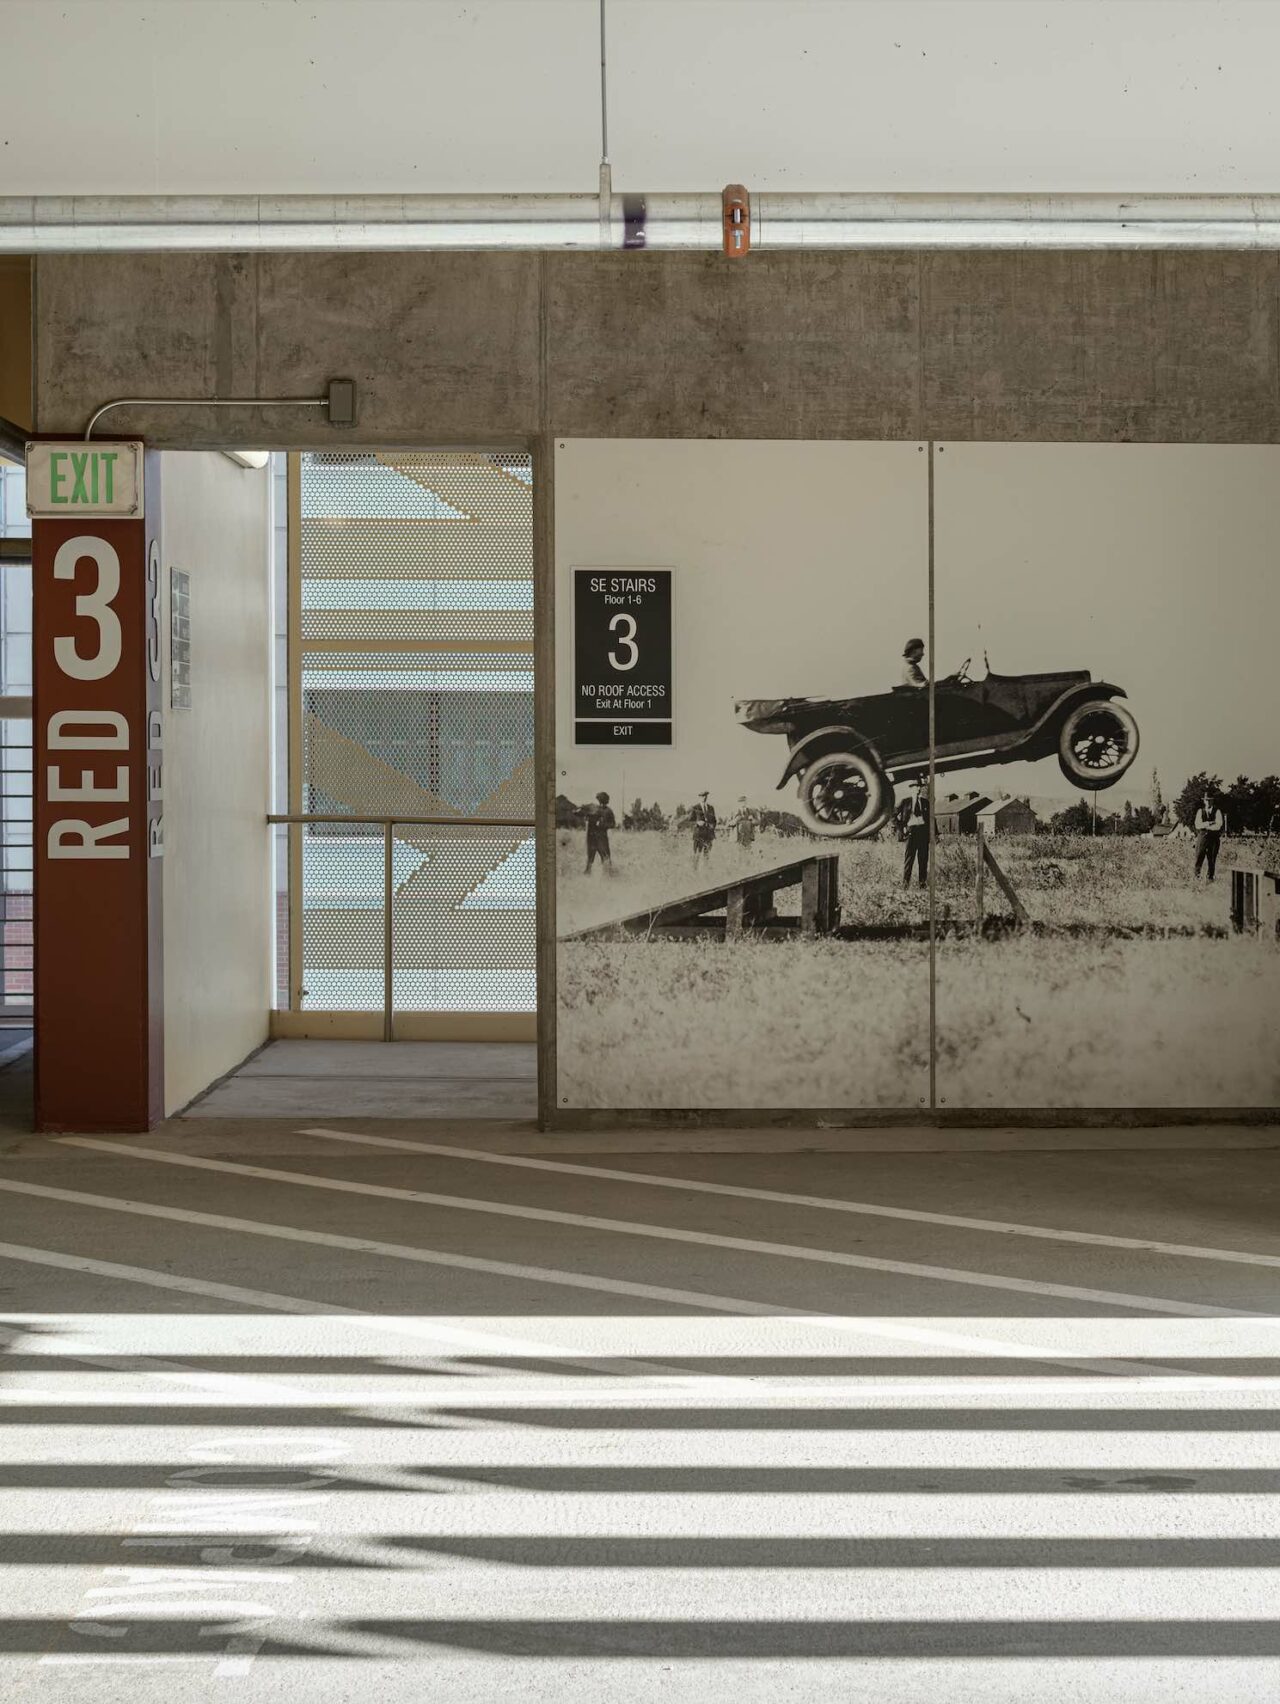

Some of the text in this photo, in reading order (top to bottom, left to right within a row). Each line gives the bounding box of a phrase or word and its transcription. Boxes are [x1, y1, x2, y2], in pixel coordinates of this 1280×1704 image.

[49, 452, 118, 504] EXIT
[53, 535, 122, 681] 3
[148, 539, 162, 682] 3
[590, 577, 656, 593] SE STAIRS
[604, 594, 642, 605] Floor 1-6
[608, 613, 639, 671] 3
[581, 685, 666, 697] NO ROOF ACCESS
[596, 699, 652, 709] Exit At Floor 1
[613, 725, 633, 736] EXIT
[47, 709, 130, 860] RED
[148, 711, 163, 858] RED
